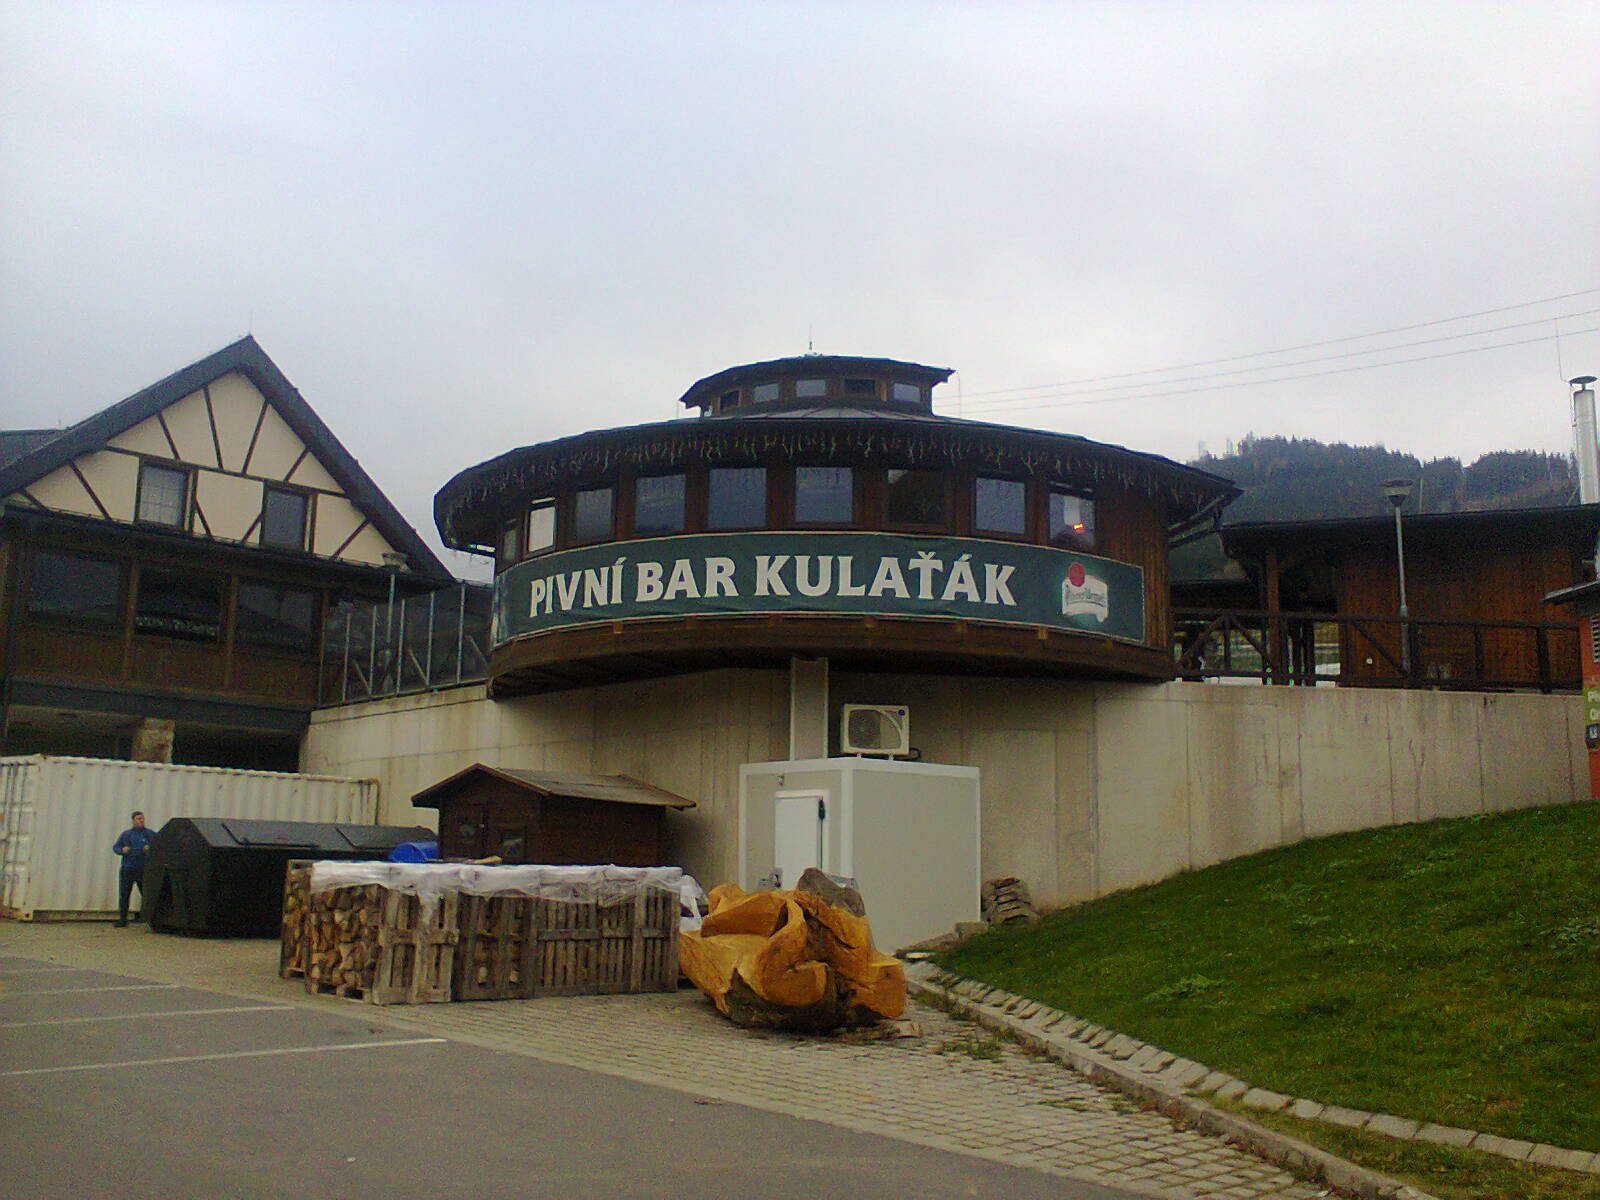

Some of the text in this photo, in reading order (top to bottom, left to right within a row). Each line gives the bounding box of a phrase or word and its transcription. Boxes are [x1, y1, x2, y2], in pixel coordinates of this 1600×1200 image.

[529, 550, 1017, 618] PIVNÍ BAR KULAŤÁK
